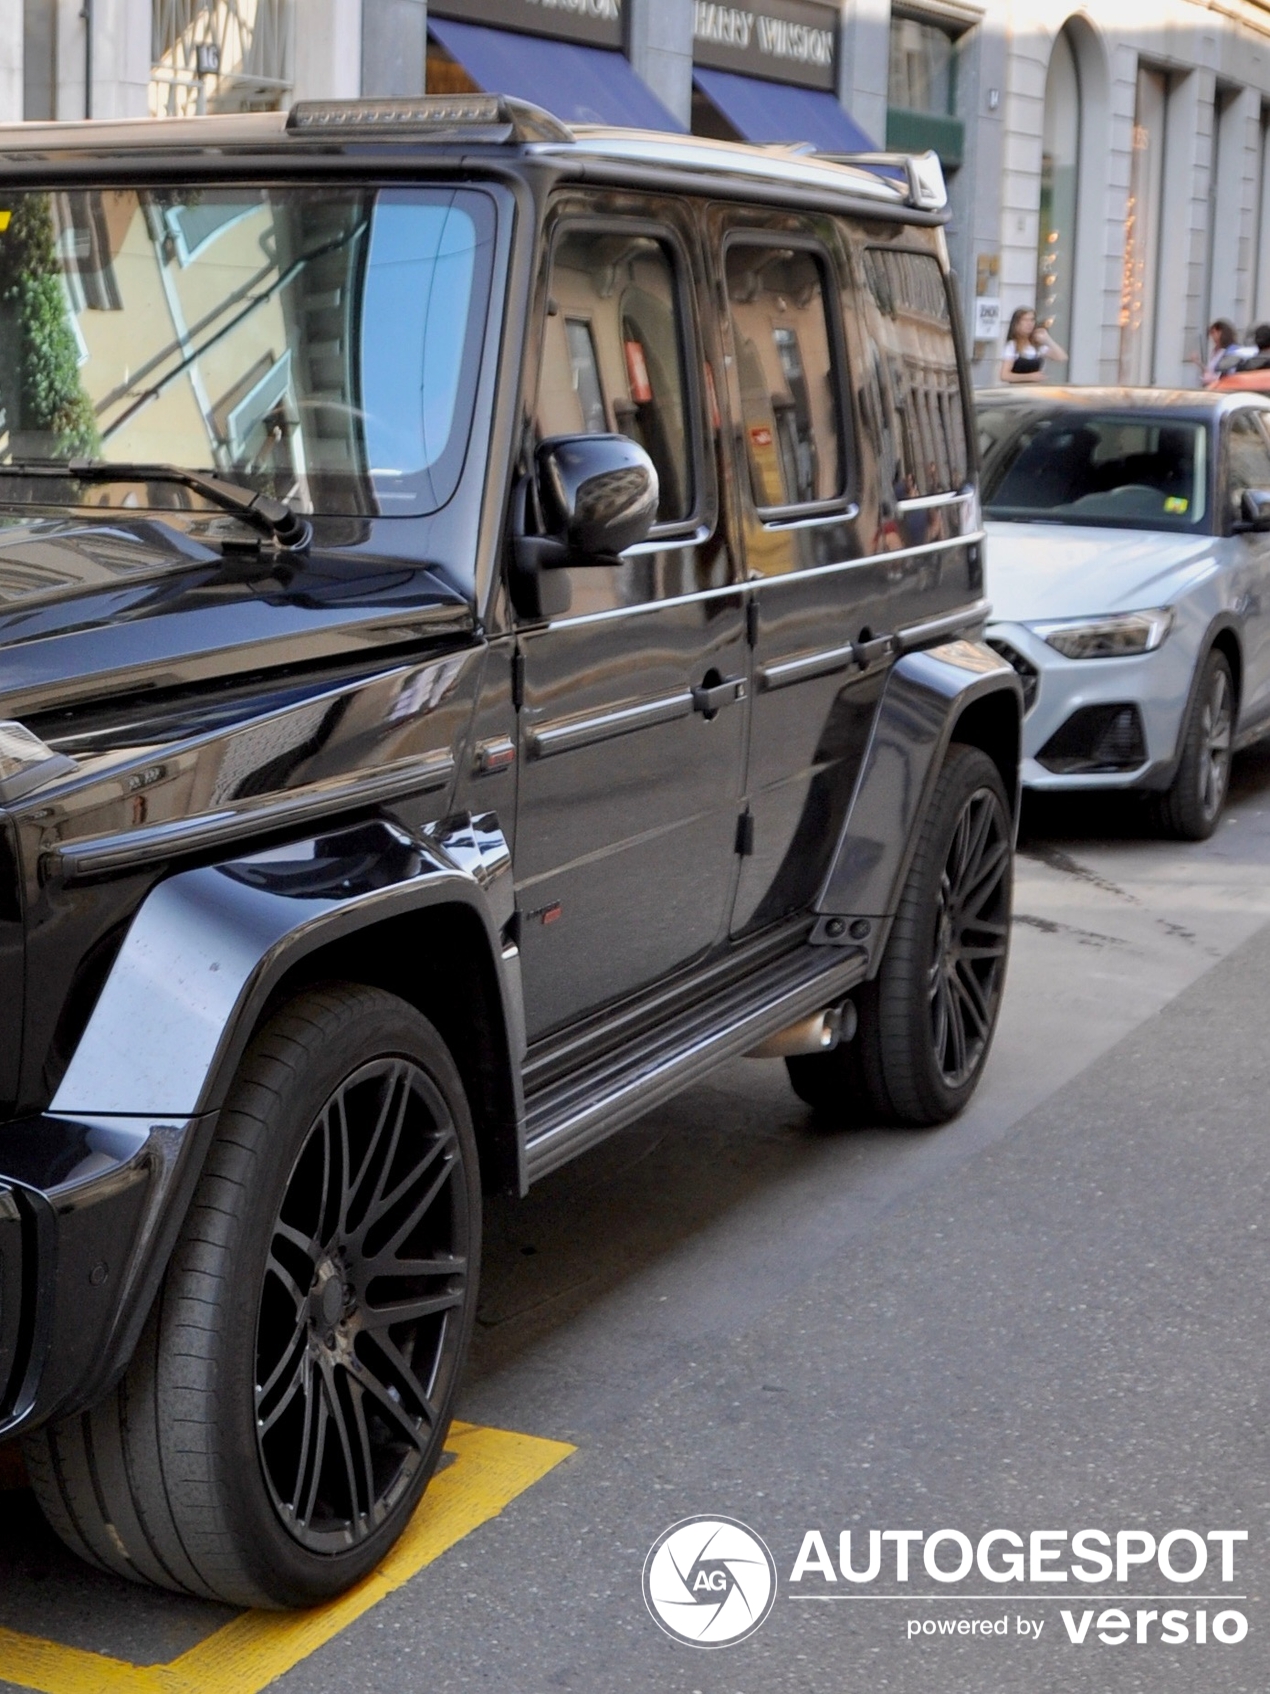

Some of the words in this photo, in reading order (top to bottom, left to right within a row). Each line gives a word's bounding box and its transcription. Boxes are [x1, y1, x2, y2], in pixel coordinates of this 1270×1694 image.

[694, 1, 754, 49] HARRY
[757, 16, 833, 64] WINSTON
[201, 45, 218, 68] 16
